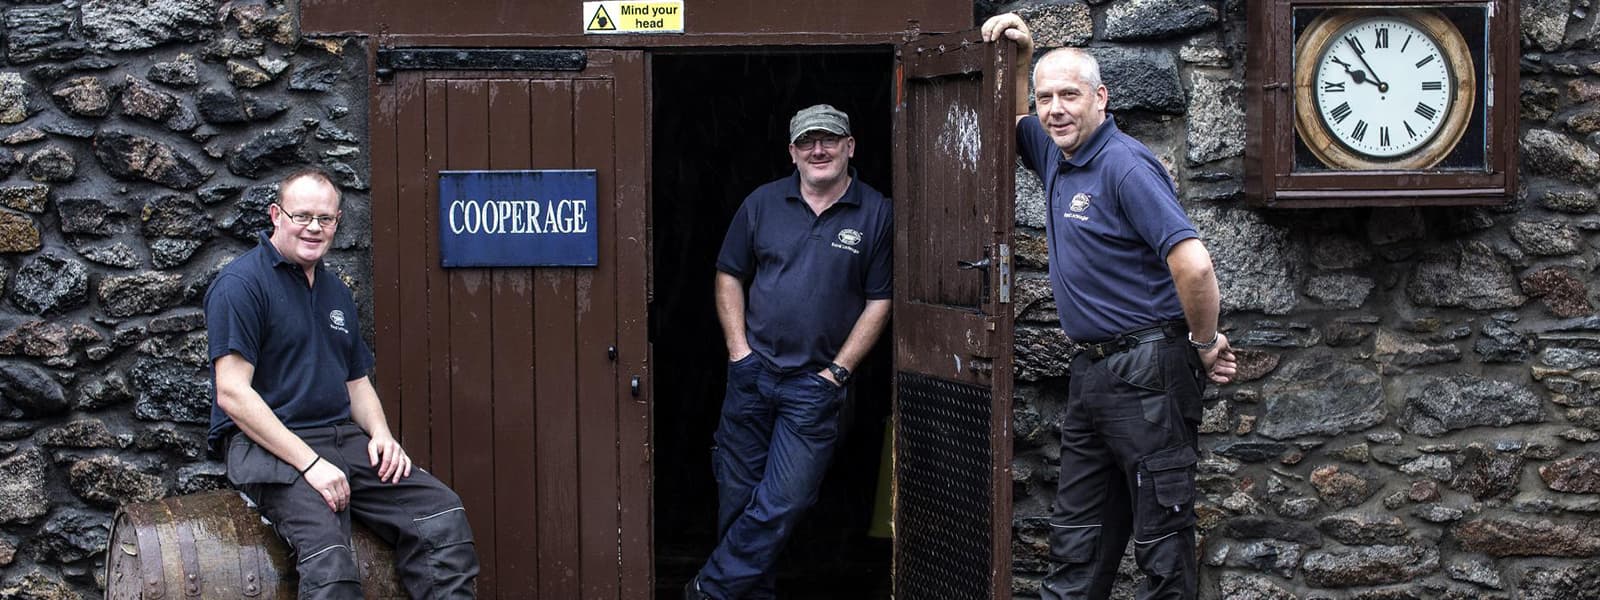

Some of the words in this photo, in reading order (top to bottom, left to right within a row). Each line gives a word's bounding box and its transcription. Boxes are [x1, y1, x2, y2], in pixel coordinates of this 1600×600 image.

[621, 5, 648, 15] Mind
[652, 6, 678, 17] your
[635, 18, 664, 28] head
[1375, 28, 1389, 49] XII
[1415, 54, 1435, 69] II
[1324, 81, 1346, 93] IX
[1421, 81, 1442, 91] III
[1380, 126, 1391, 147] VI
[449, 199, 588, 235] COOPERAGE
